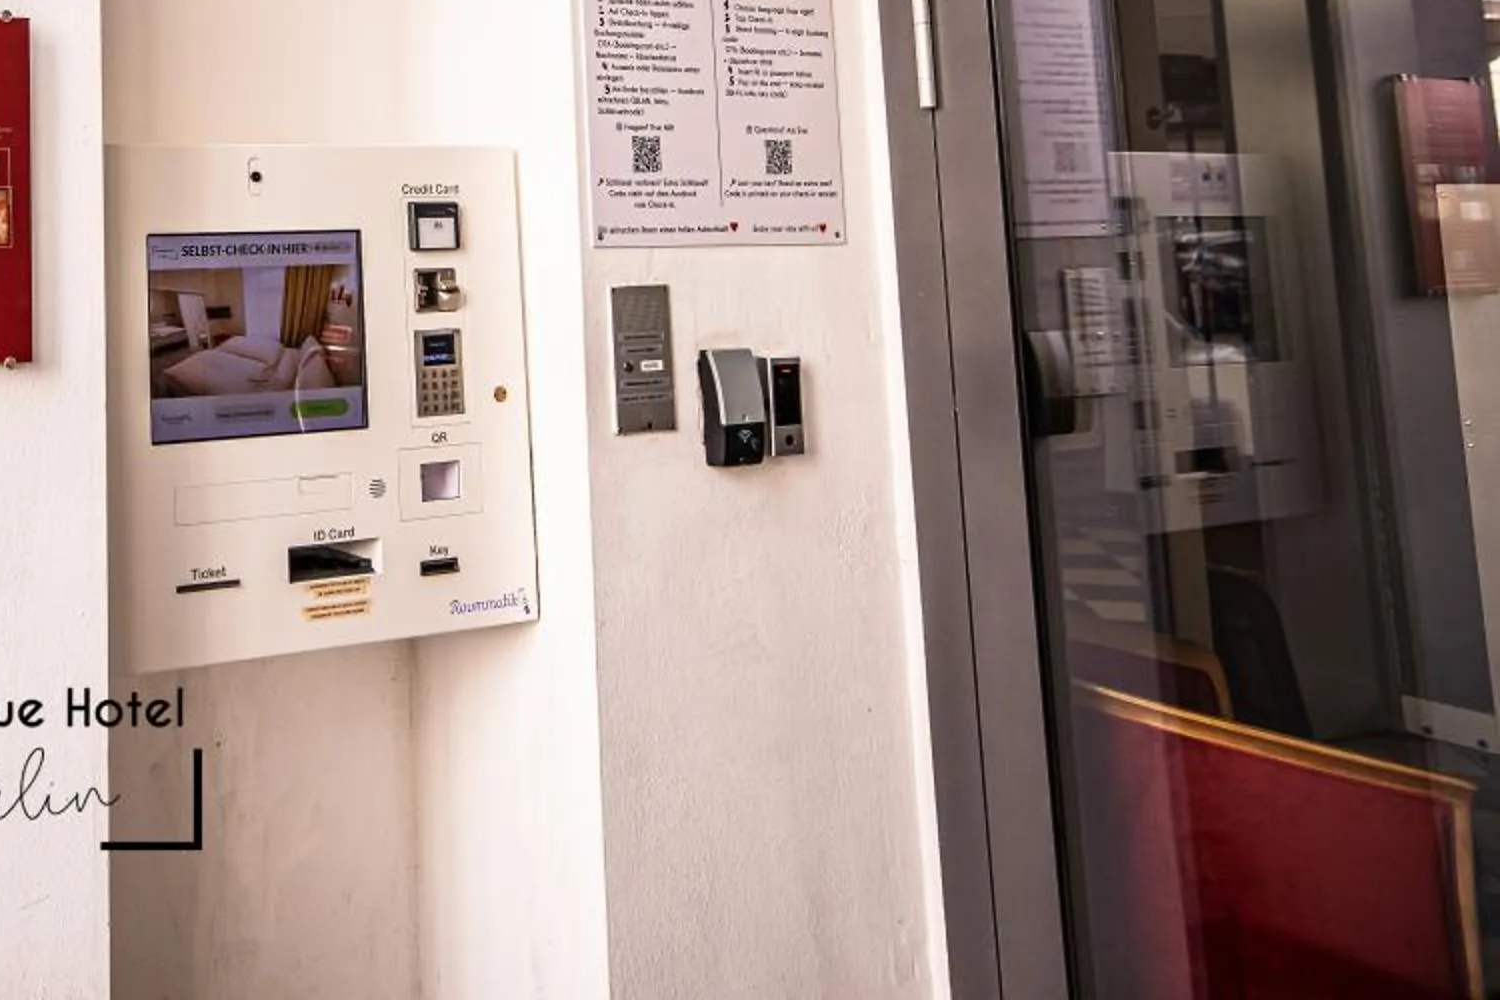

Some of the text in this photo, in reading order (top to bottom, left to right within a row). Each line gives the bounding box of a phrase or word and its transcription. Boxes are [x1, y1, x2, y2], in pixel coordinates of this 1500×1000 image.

[401, 183, 434, 196] Credit
[431, 431, 448, 444] QR
[313, 526, 355, 541] ID Card
[429, 544, 449, 556] Key
[190, 566, 227, 581] Ticket
